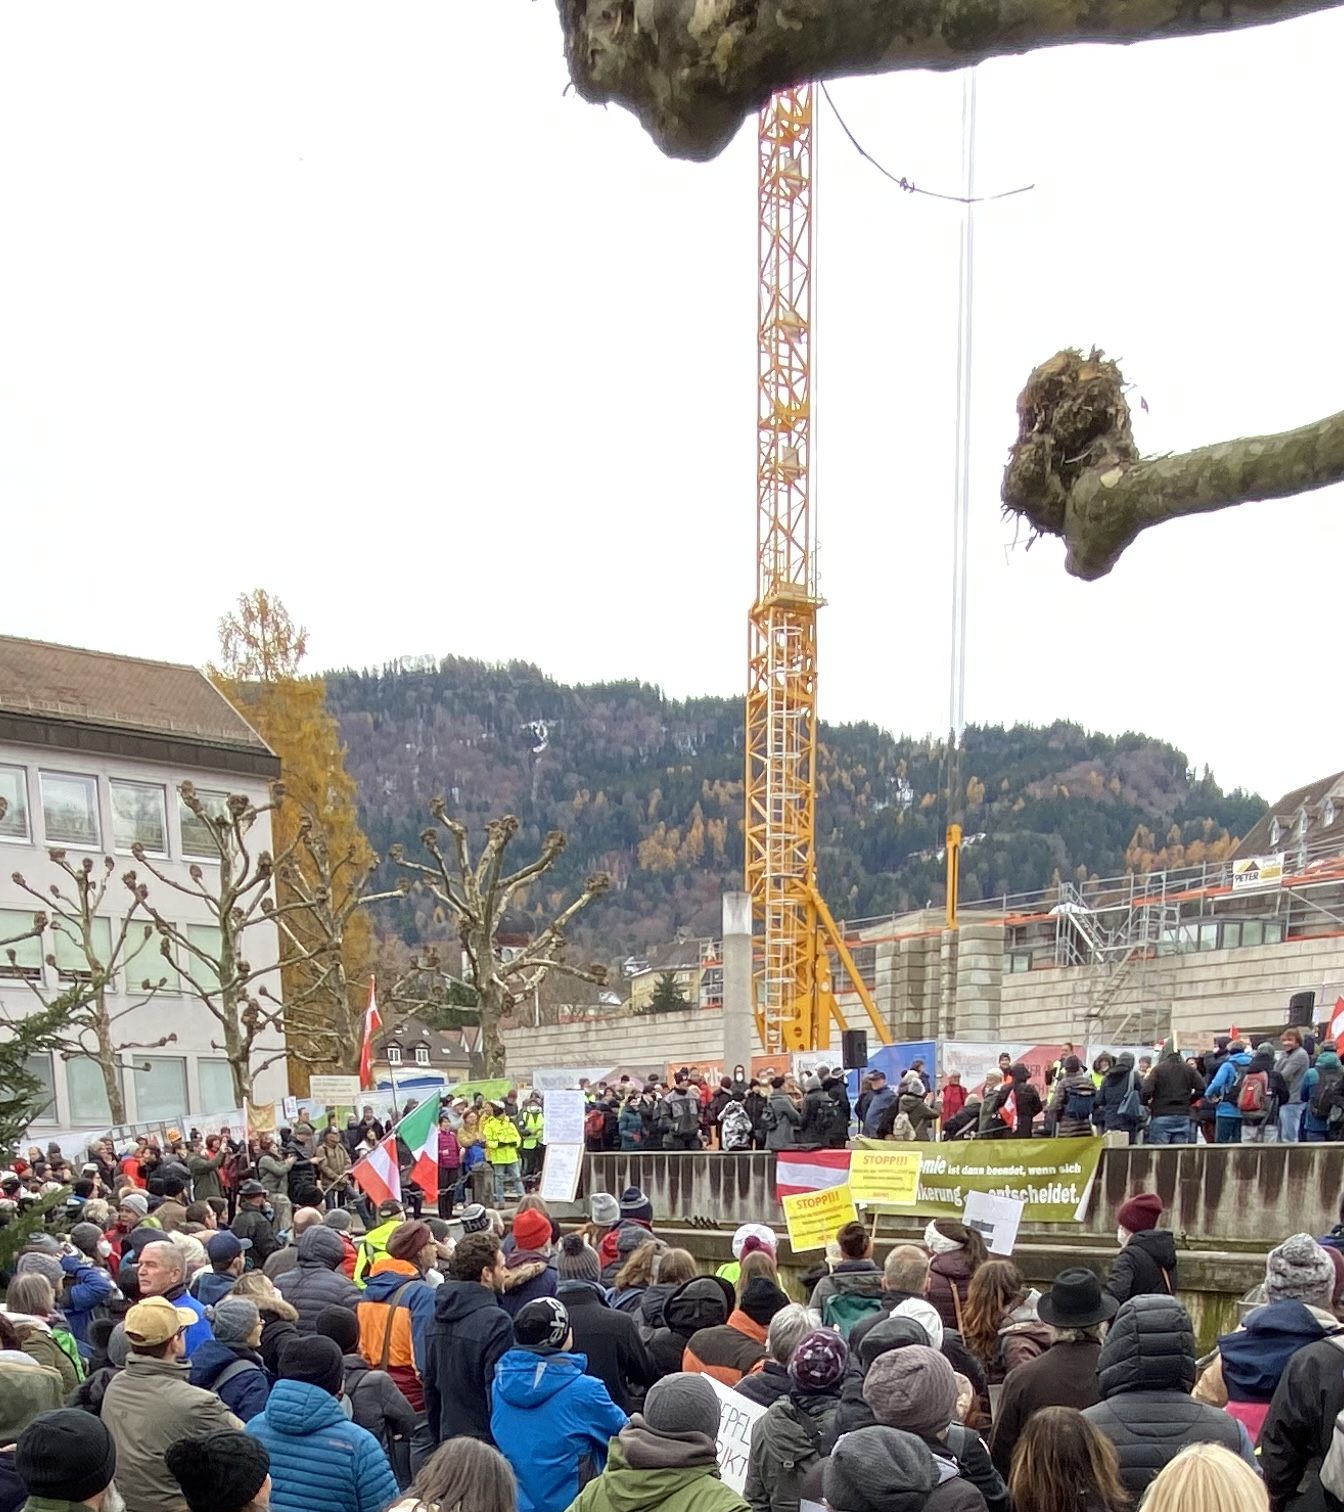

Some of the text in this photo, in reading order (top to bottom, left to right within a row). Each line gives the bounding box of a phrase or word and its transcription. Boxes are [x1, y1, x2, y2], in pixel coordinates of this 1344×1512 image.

[862, 1155, 908, 1166] STOPP!!!
[920, 1155, 947, 1175] mie
[947, 1164, 960, 1175] ist
[961, 1164, 985, 1175] dann
[986, 1164, 1027, 1177] beendet,
[1028, 1166, 1056, 1175] wenn
[1058, 1163, 1082, 1175] sich
[795, 1190, 841, 1210] STOPP!!!
